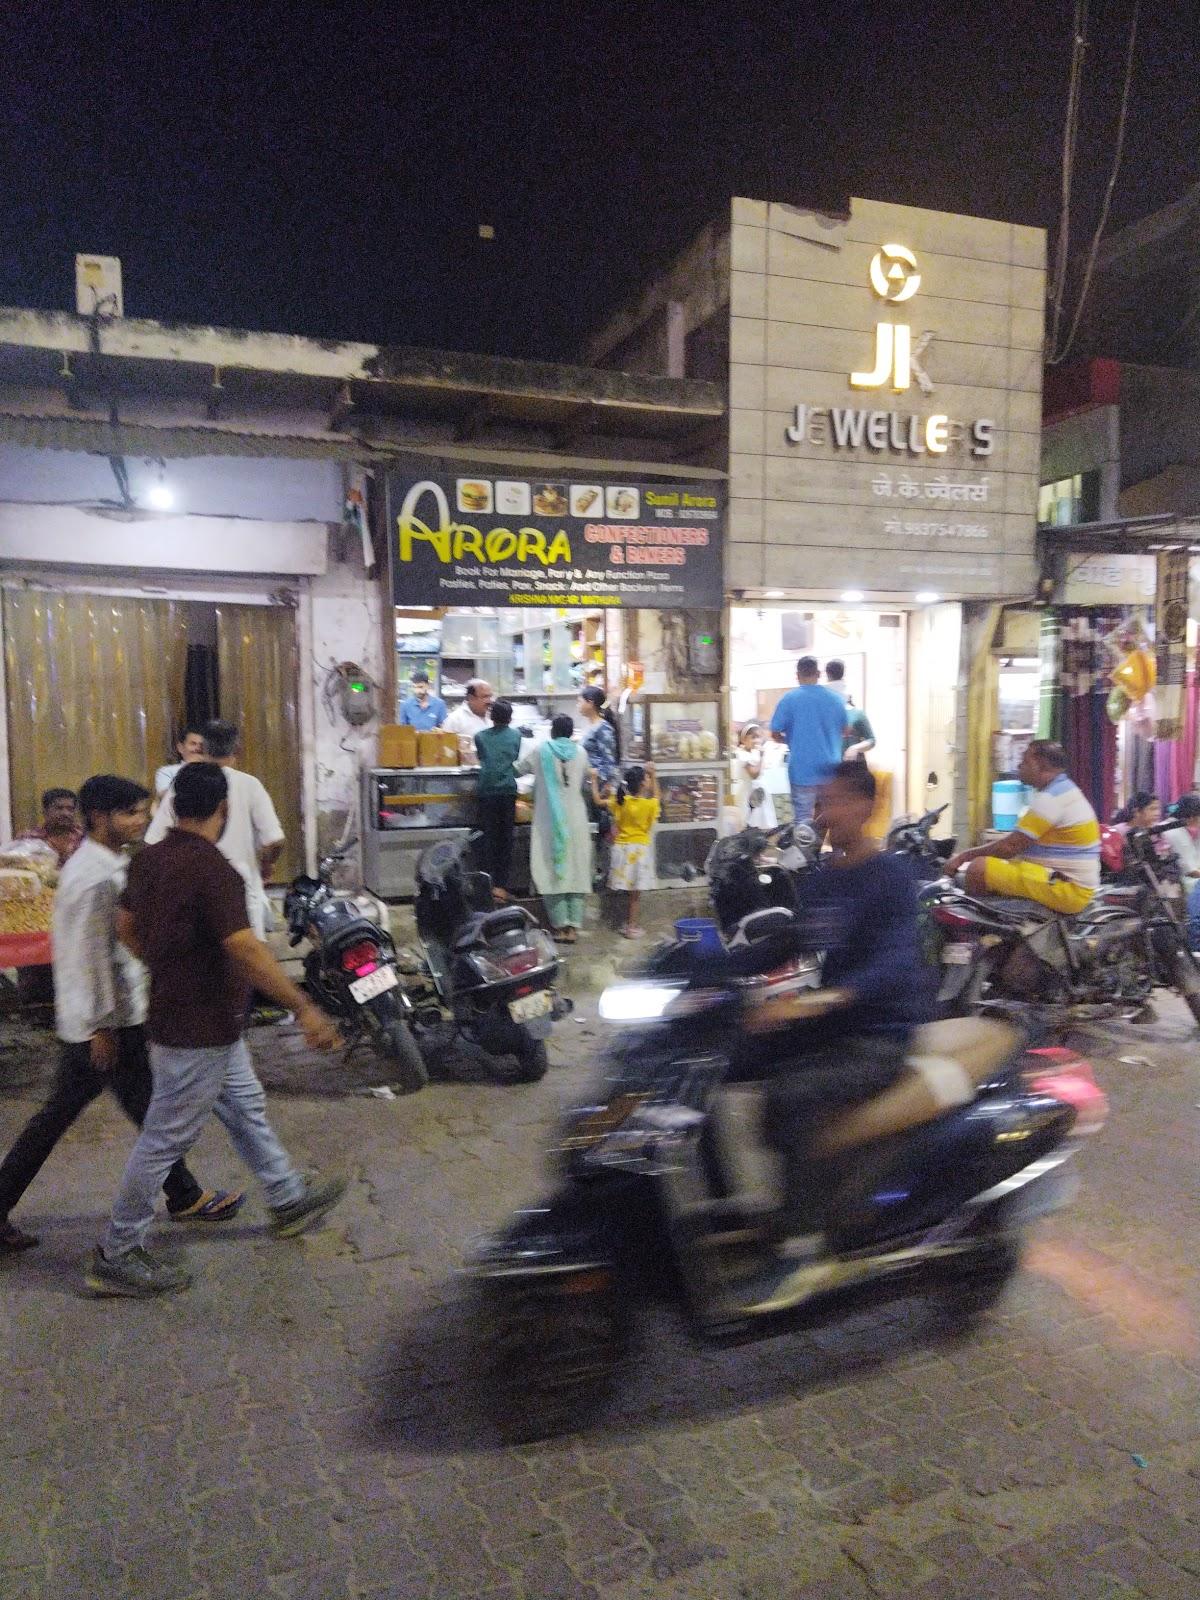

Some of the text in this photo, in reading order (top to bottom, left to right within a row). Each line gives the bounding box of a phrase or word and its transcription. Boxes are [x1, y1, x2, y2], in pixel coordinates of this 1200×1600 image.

[851, 323, 936, 394] JK
[584, 524, 709, 546] CONFECTIONERS
[609, 545, 686, 566] & BAKERS
